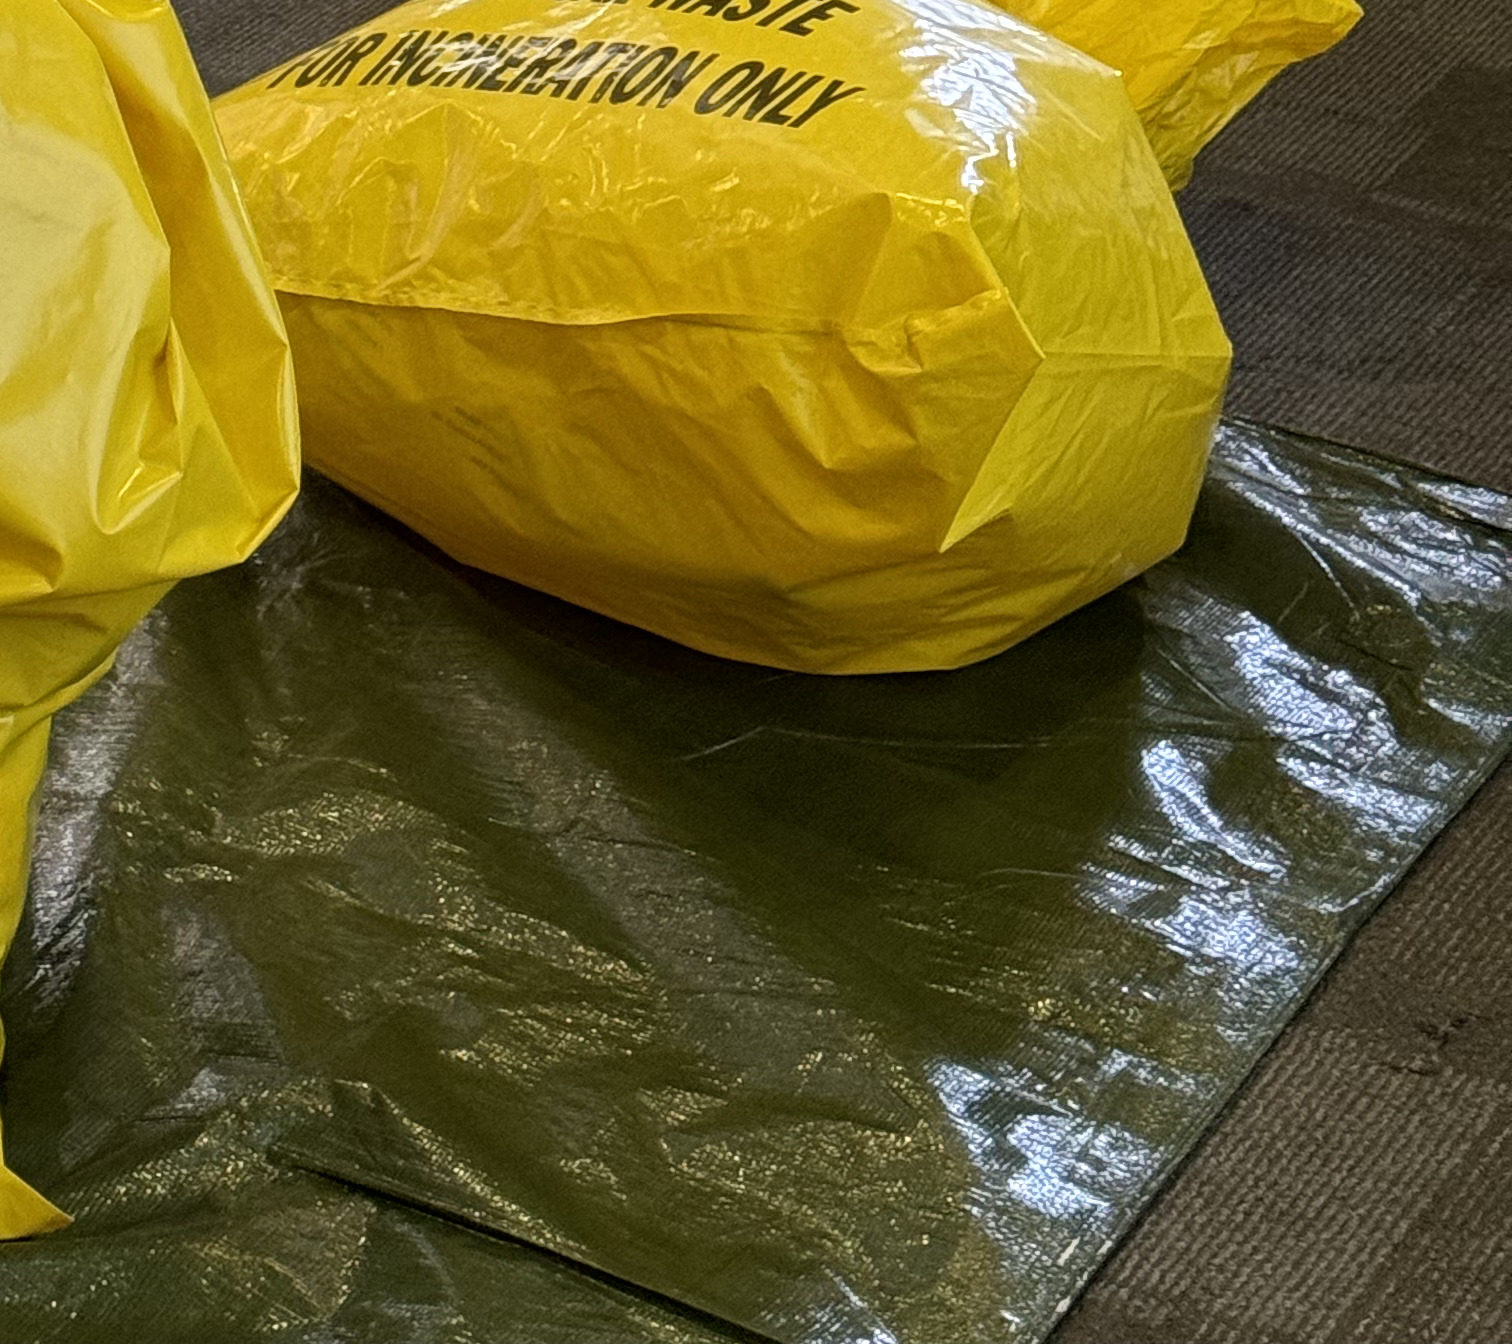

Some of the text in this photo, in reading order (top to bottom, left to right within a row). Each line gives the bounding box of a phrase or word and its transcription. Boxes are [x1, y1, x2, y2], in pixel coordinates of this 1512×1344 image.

[266, 30, 865, 129] FOR INCINERATION ONLY
